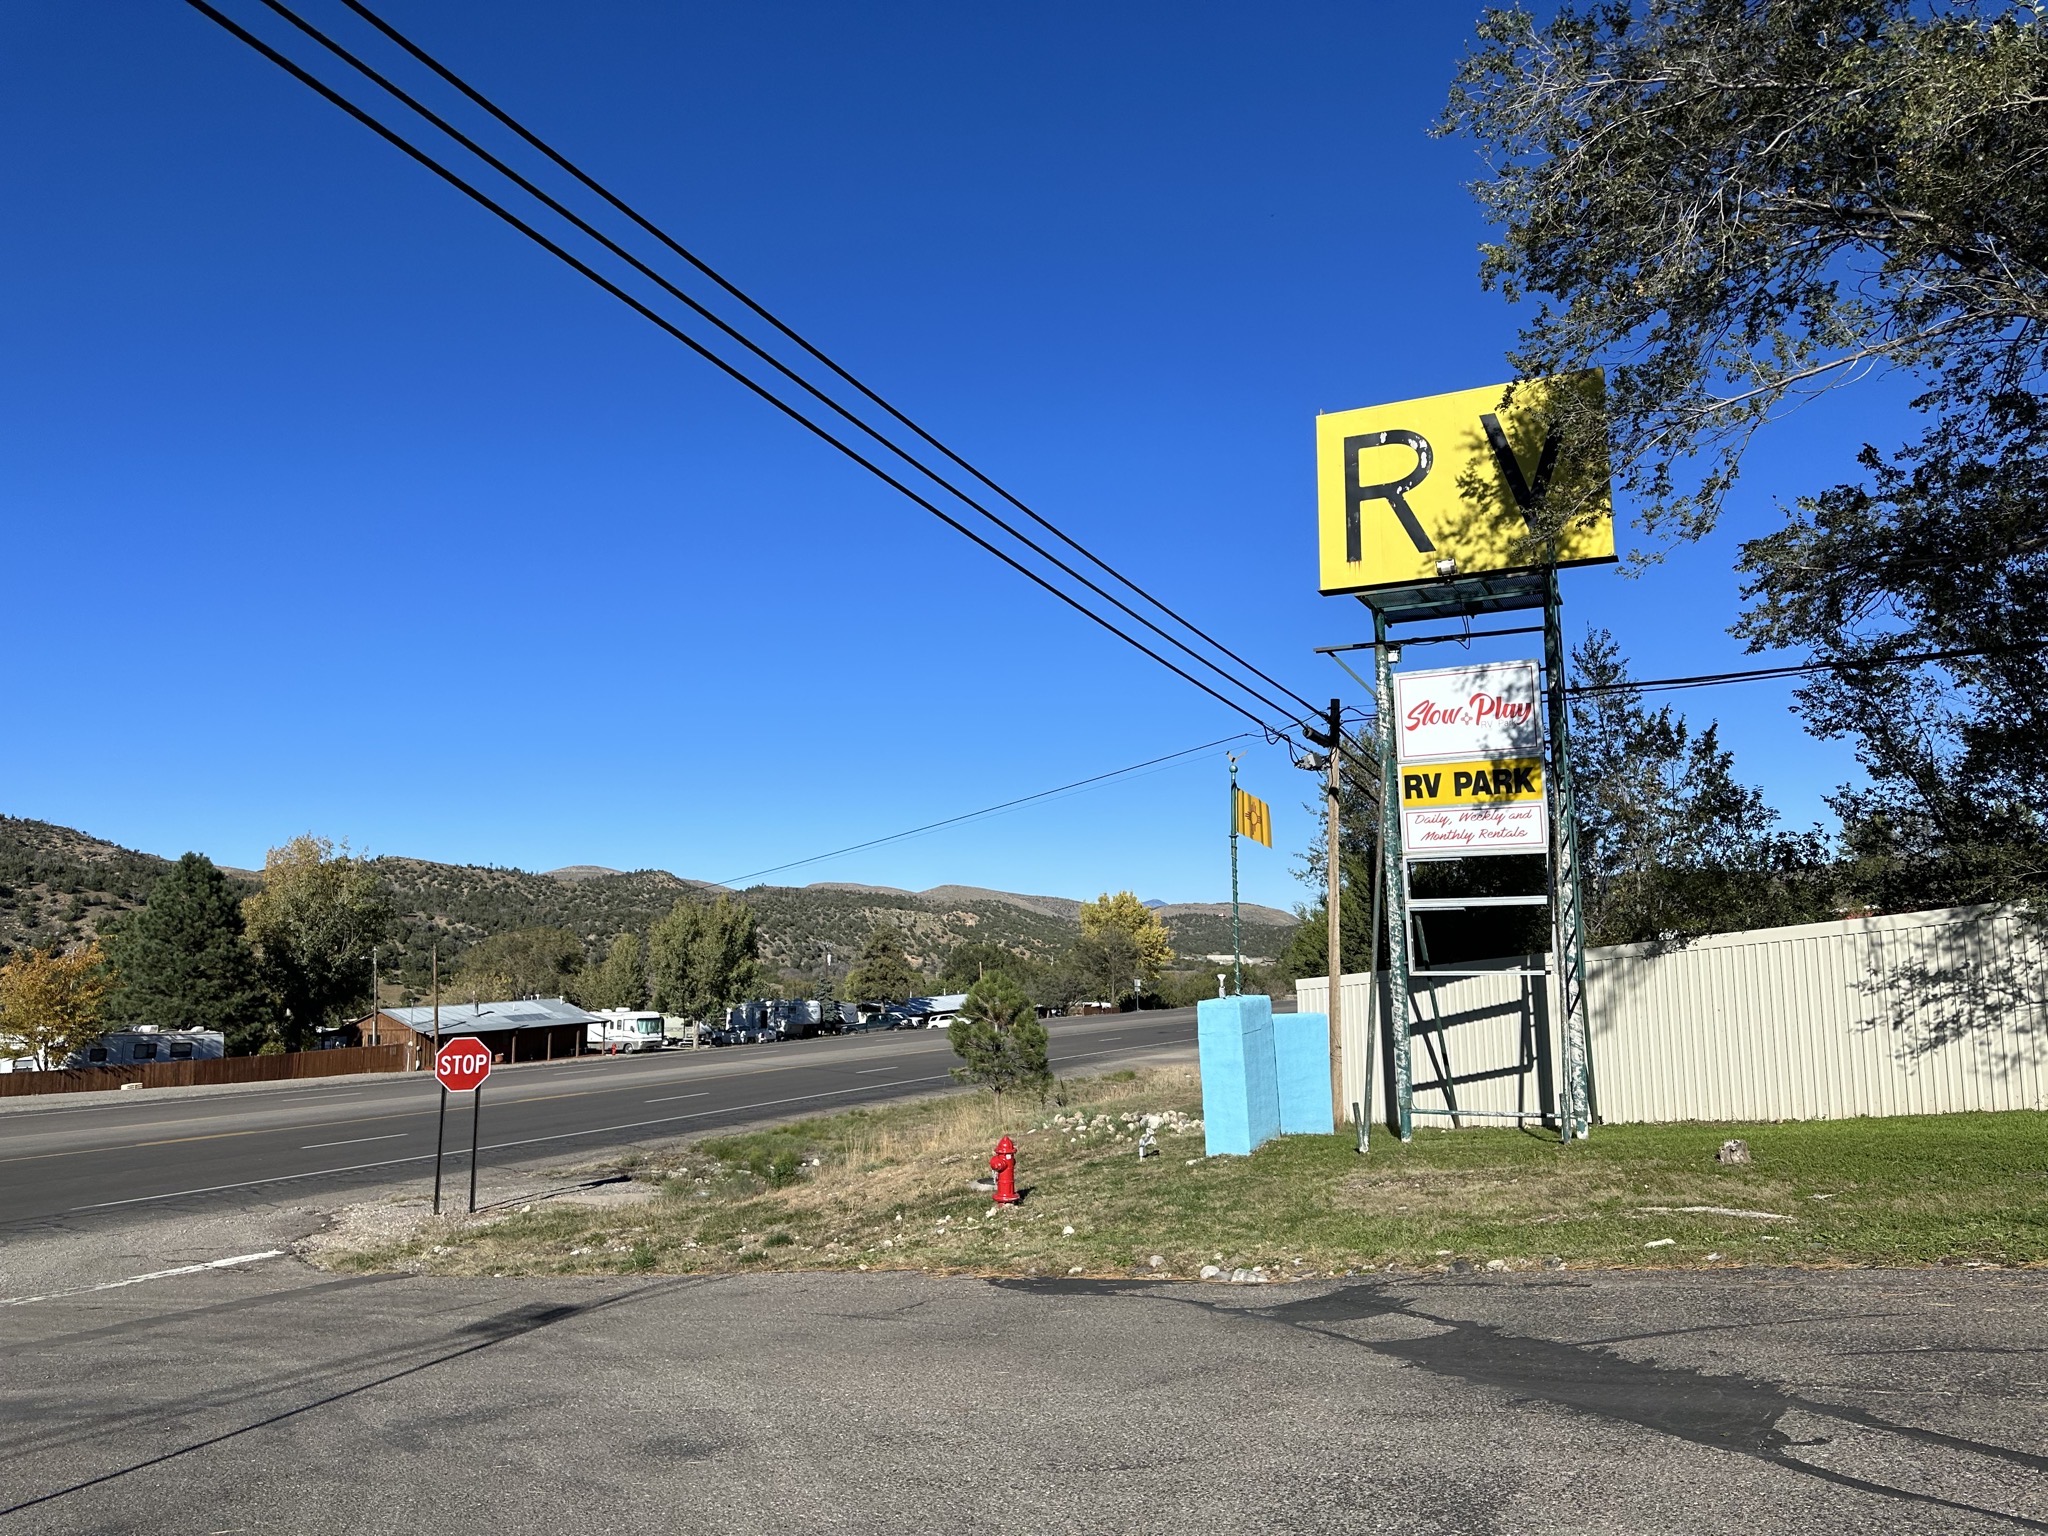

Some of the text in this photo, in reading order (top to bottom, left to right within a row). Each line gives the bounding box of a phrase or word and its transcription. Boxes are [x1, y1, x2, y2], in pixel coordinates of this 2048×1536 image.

[1405, 693, 1532, 731] Slow Play
[1480, 720, 1493, 729] RV
[1404, 767, 1536, 799] RV PARK
[1415, 809, 1533, 828] Daily, Weekly and
[1421, 827, 1528, 845] Monthly Rentals
[440, 1054, 487, 1076] STOP
